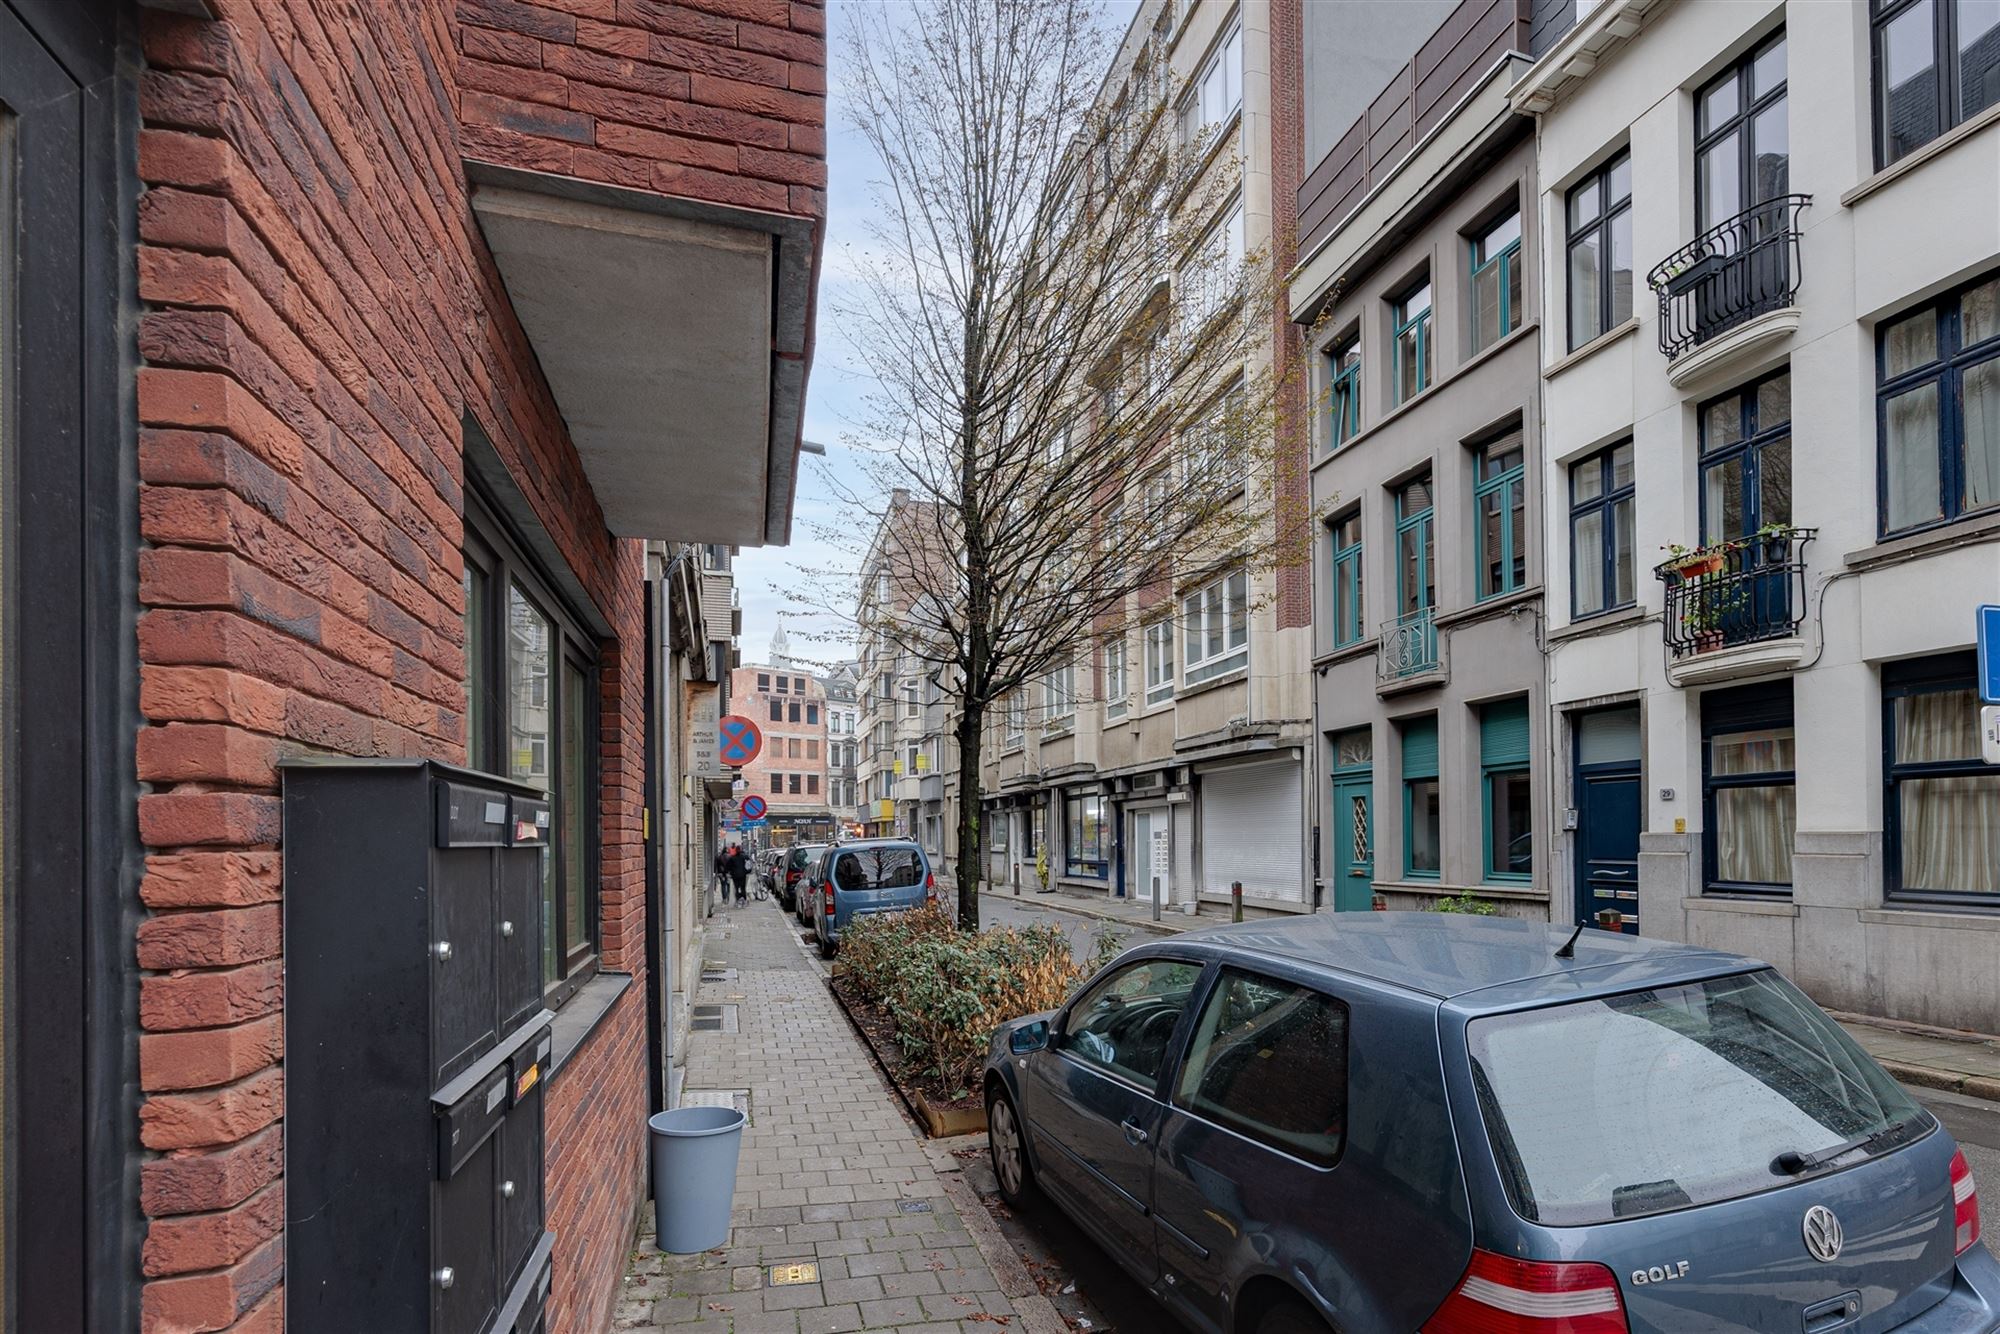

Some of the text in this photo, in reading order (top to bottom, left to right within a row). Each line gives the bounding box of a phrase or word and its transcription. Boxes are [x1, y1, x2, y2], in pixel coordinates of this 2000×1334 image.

[697, 761, 710, 771] 20
[1662, 790, 1671, 798] 29
[1631, 1260, 1690, 1286] GOLF
